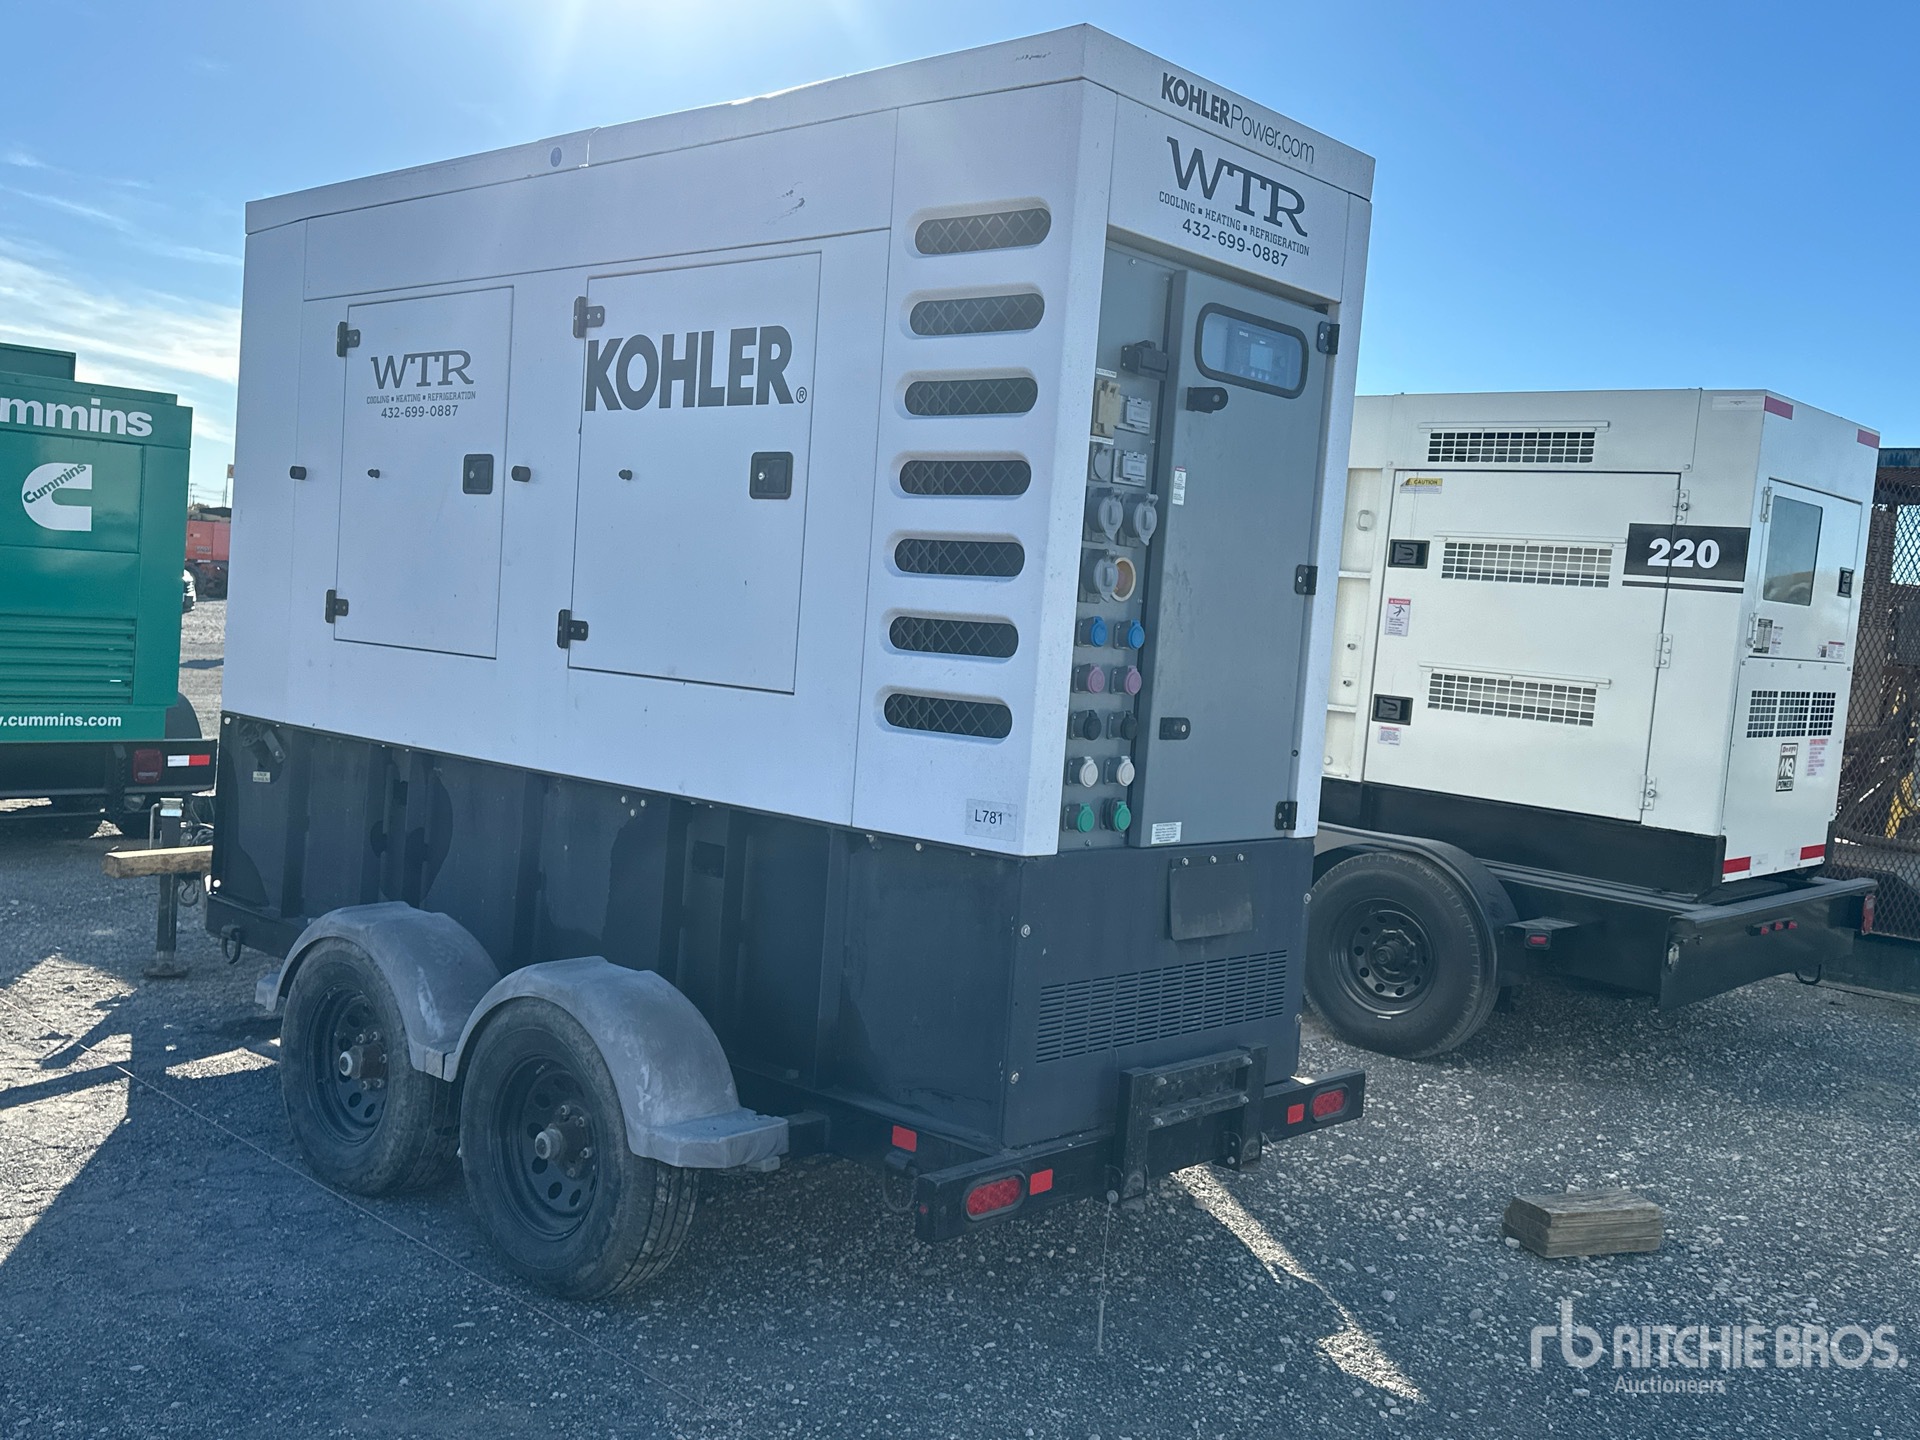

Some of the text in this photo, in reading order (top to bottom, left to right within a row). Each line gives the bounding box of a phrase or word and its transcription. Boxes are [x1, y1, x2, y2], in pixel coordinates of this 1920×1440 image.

[1161, 72, 1315, 164] KOHLERPower.com
[1166, 136, 1308, 237] WTR
[1159, 191, 1310, 256] COOLING HEATING REFRIGERATION
[1182, 218, 1289, 267] 432-699-0887
[370, 350, 475, 389] WTR
[584, 325, 795, 412] KOHLER
[366, 391, 476, 405] COOLING HEATING REFRIGERATION
[381, 405, 459, 418] 432-699-0887
[23, 463, 87, 504] Cummins
[1647, 537, 1720, 569] 220
[1779, 757, 1794, 778] MQ
[974, 809, 1003, 825] L781
